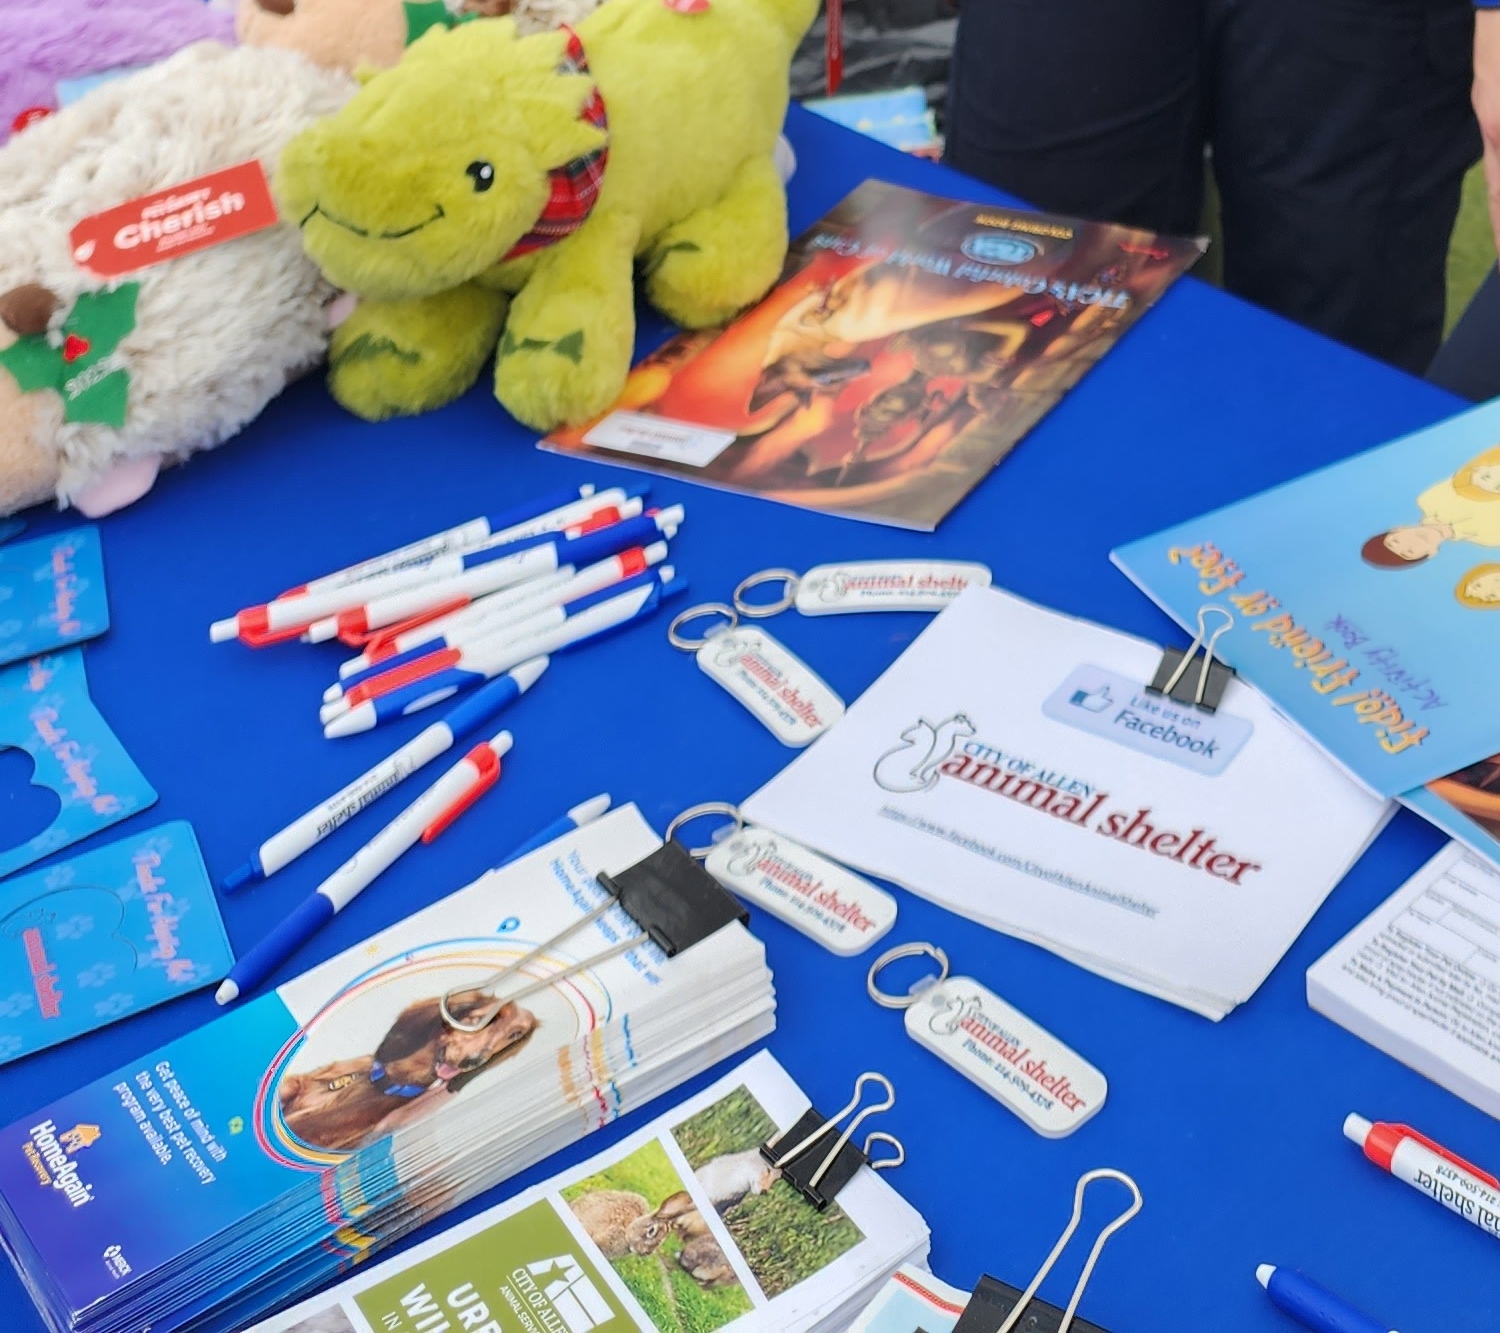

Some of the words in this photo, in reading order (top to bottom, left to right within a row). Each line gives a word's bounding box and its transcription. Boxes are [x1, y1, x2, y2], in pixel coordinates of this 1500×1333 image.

[113, 191, 245, 250] Cherish
[844, 574, 913, 589] animal
[1168, 541, 1246, 596] Foe?
[1252, 612, 1360, 694] Friend
[738, 644, 789, 697] animal
[776, 679, 827, 732] shelter
[1129, 694, 1161, 714] Like
[1161, 704, 1180, 722] us
[1181, 713, 1201, 728] on
[1114, 708, 1221, 759] Facebook
[962, 740, 1008, 771] CITY
[1008, 755, 1034, 775] OF
[1035, 763, 1096, 797] ALLEN
[353, 771, 403, 809] animal
[311, 801, 360, 839] shelter
[940, 751, 1110, 829] animal
[1099, 805, 1263, 886] shelter
[755, 848, 824, 902] animal
[811, 881, 882, 936] shelter
[133, 1069, 156, 1092] the
[153, 1058, 176, 1083] Get
[958, 1007, 1032, 1069] animal
[1016, 1050, 1093, 1116] shelter
[141, 1085, 168, 1115] very
[162, 1076, 192, 1112] peace
[181, 1104, 202, 1122] of
[110, 1079, 149, 1126] program
[137, 1117, 176, 1166] available.
[156, 1106, 183, 1135] best
[168, 1127, 193, 1153] pet
[189, 1115, 216, 1146] mind
[27, 1119, 97, 1209] HomeAgain
[180, 1144, 217, 1188] recovery
[204, 1137, 229, 1164] with
[1409, 1168, 1478, 1217] shelter
[499, 1285, 526, 1318] ANIMAL
[511, 1268, 538, 1297] CITY
[528, 1290, 548, 1310] OF
